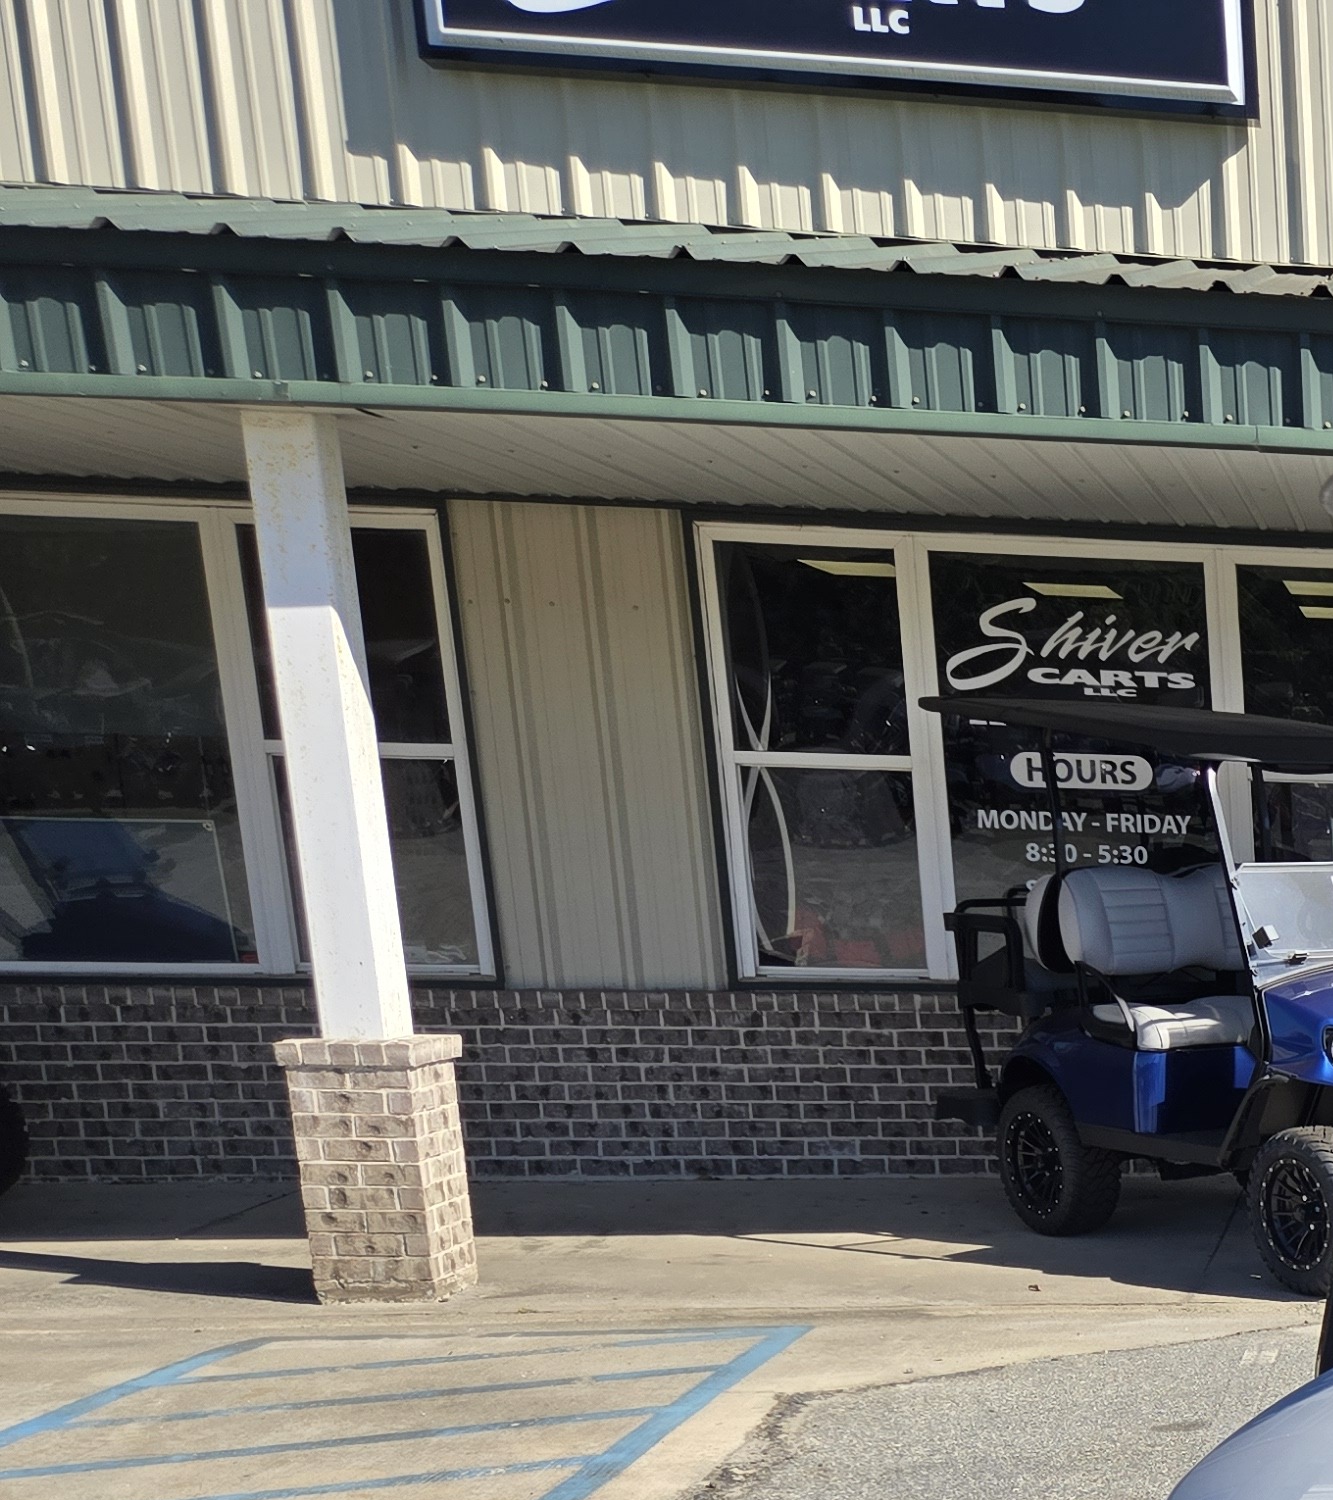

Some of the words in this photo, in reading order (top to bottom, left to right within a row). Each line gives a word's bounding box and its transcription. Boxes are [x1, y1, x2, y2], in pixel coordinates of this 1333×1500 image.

[852, 6, 910, 35] LLC
[946, 597, 1200, 690] Shiver
[1027, 667, 1196, 689] CARTS
[1084, 687, 1137, 697] LLC
[1026, 757, 1137, 785] HOURS
[977, 809, 1087, 832] MONDAY
[1106, 813, 1191, 834] FRIDAY
[1098, 845, 1148, 865] 5:30
